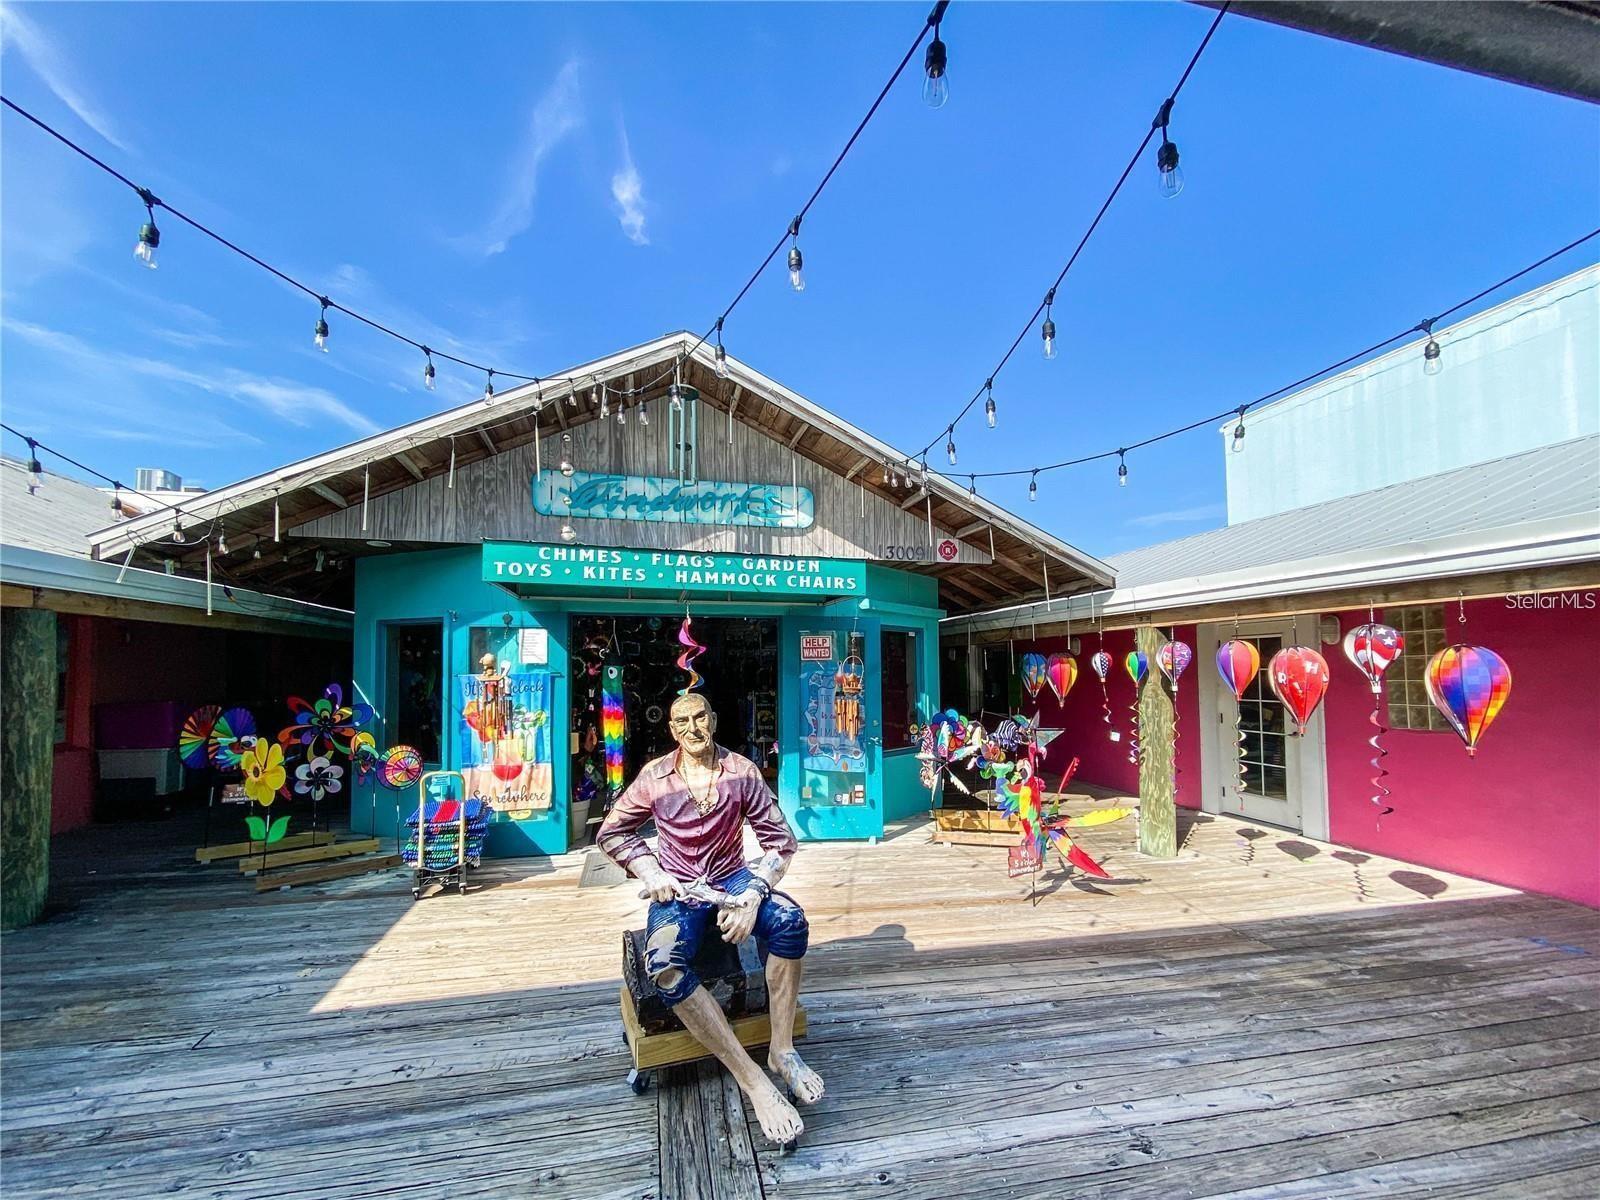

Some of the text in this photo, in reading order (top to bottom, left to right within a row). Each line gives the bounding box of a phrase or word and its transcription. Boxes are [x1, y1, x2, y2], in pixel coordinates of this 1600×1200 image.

[538, 547, 820, 573] CHIMES FLAGS GARDEN
[494, 561, 857, 590] TOYS KITES HAMMOCK CHAIRS
[805, 638, 827, 647] HELP
[803, 648, 830, 657] WANTED
